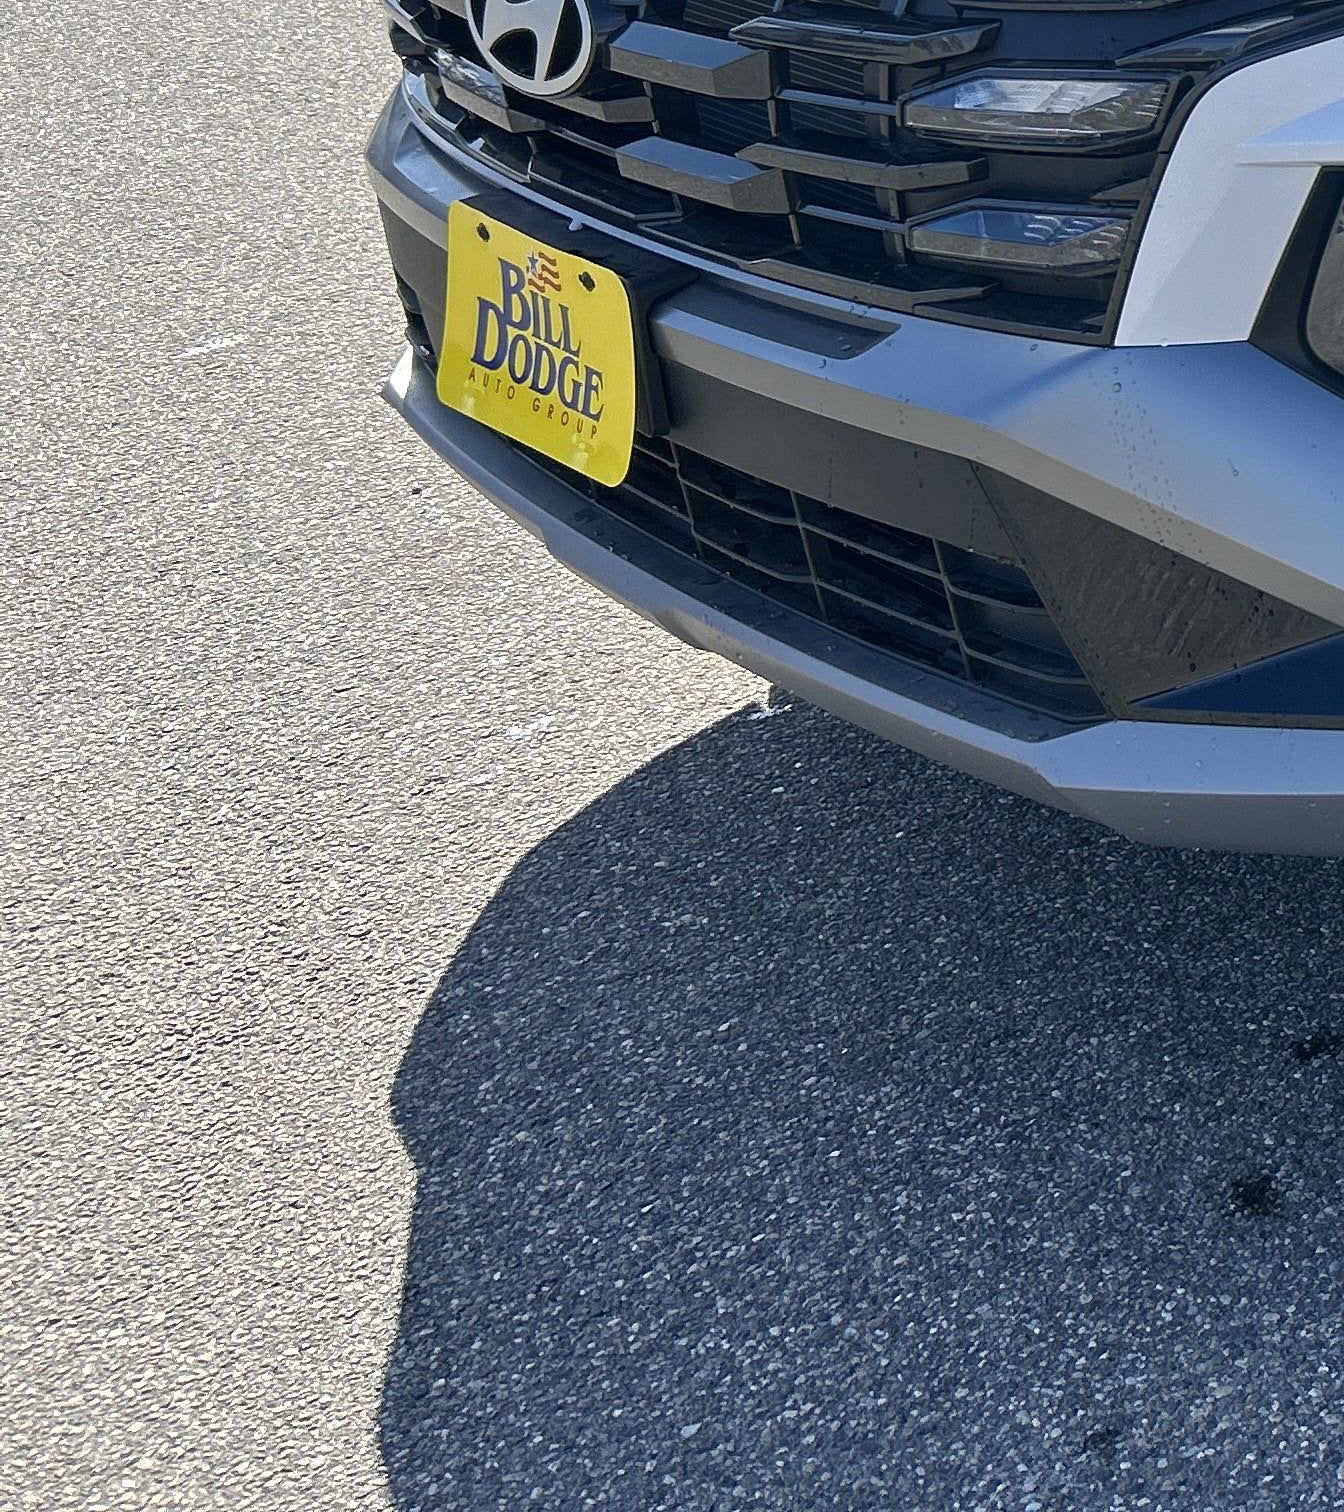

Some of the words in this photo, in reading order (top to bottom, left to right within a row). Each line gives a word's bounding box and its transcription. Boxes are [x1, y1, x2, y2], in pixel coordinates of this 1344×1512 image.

[498, 258, 582, 358] BILL
[468, 367, 516, 400] AUTO
[532, 397, 598, 440] GROUP
[471, 296, 605, 423] DODGE
